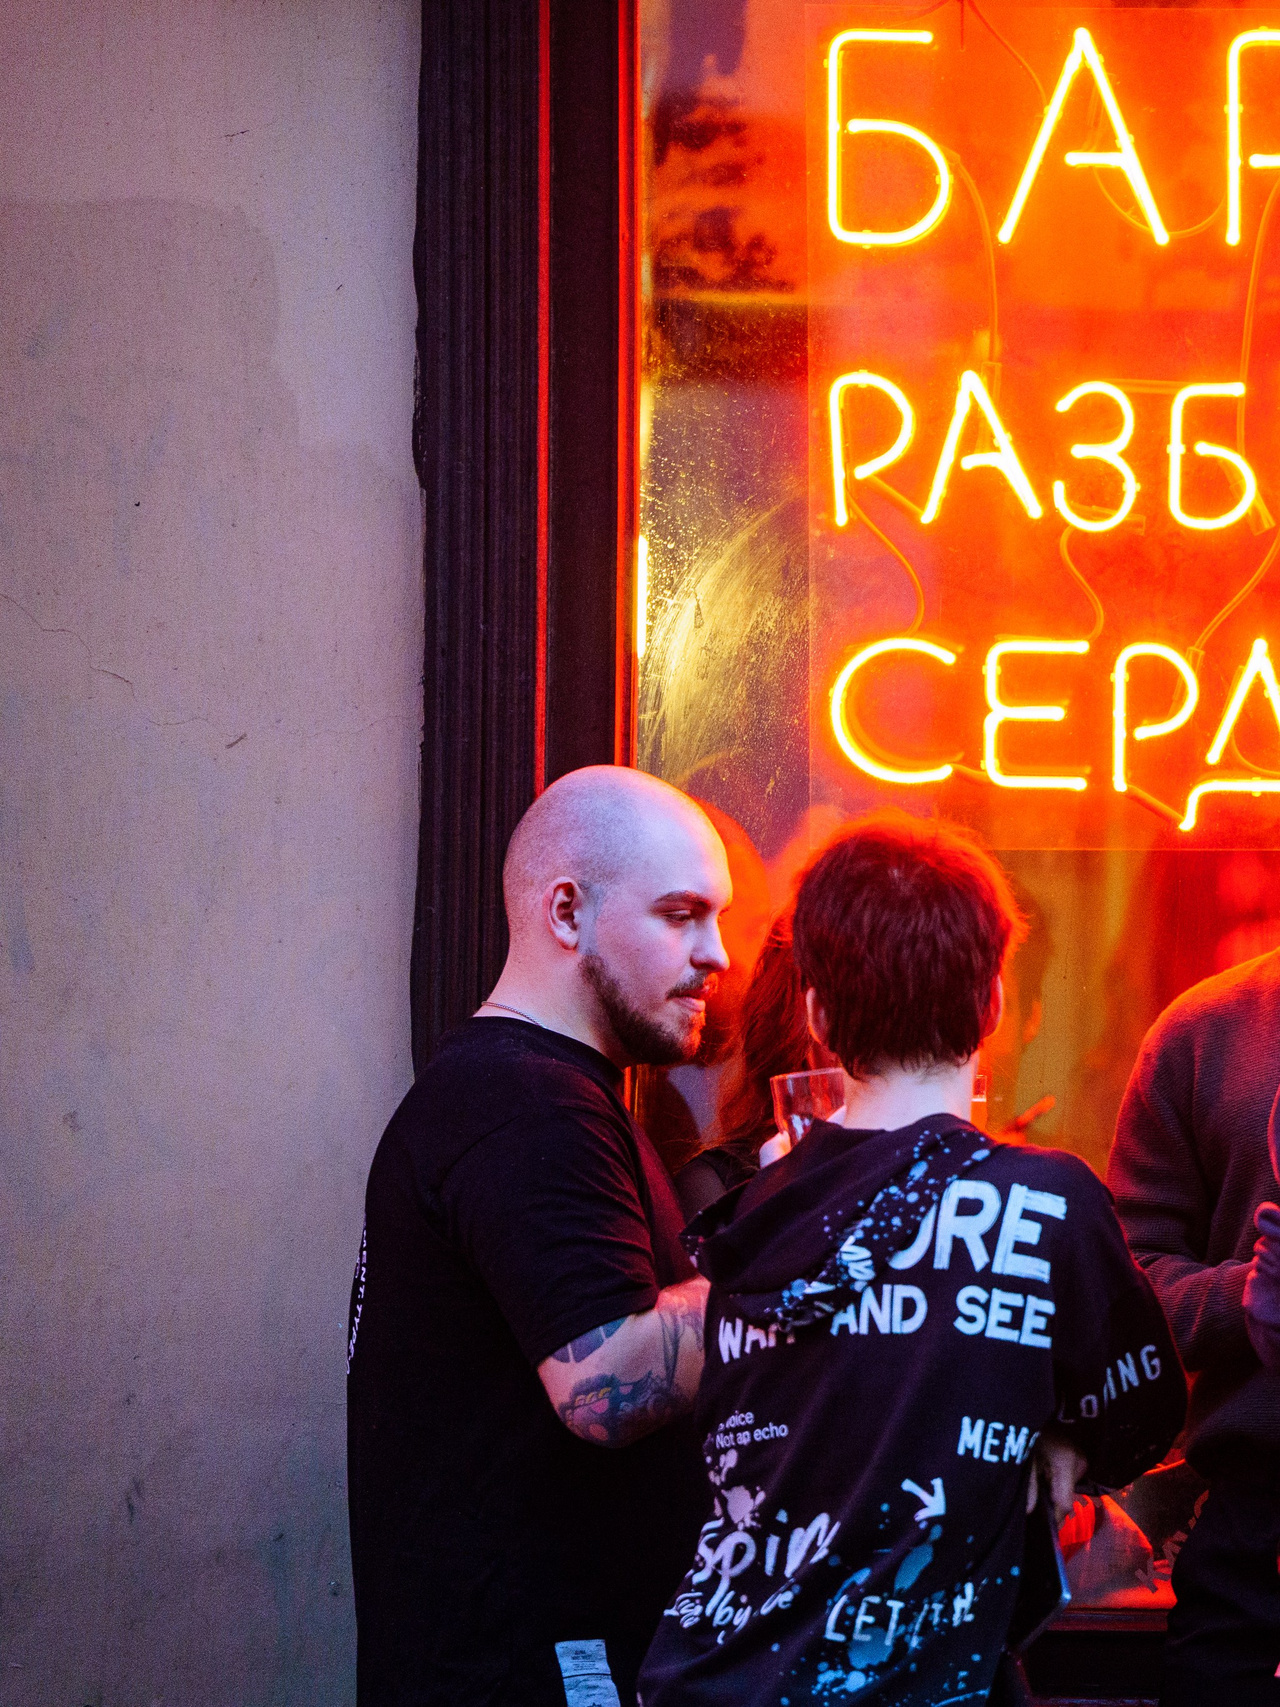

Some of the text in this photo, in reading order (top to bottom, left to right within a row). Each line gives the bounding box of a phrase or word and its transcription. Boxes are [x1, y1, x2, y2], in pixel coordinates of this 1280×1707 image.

[830, 1283, 928, 1338] AND
[953, 1285, 1057, 1349] SEE
[1057, 1344, 1162, 1423] LOING
[715, 1432, 736, 1449] Not
[753, 1421, 790, 1442] echo
[957, 1415, 1041, 1465] MEM
[824, 1594, 905, 1647] LET
